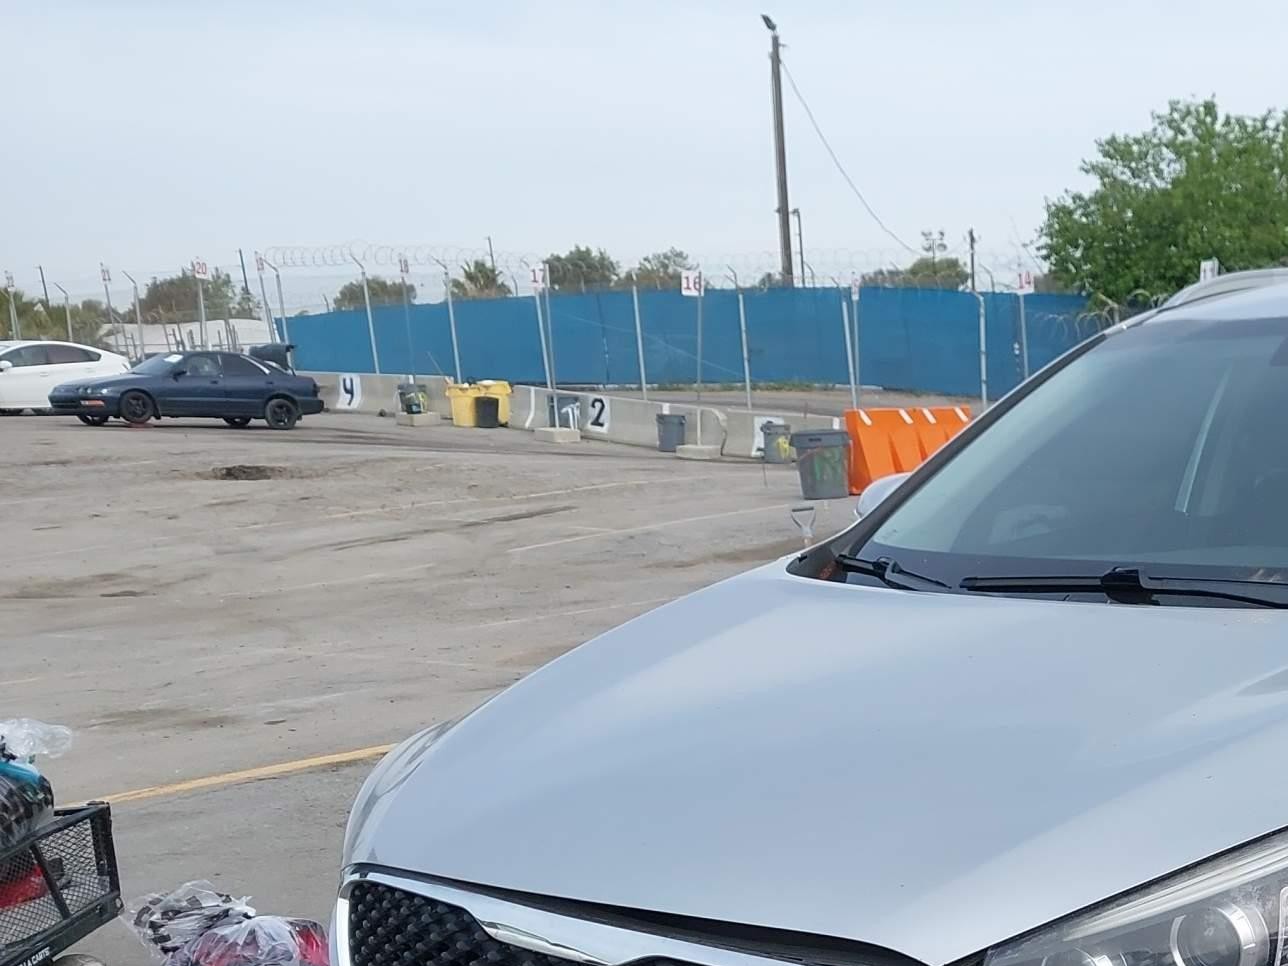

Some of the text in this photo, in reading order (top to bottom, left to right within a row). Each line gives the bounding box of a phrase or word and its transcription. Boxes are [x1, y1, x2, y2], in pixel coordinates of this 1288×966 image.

[195, 261, 207, 276] 20
[684, 275, 703, 292] 16
[590, 397, 606, 427] 2
